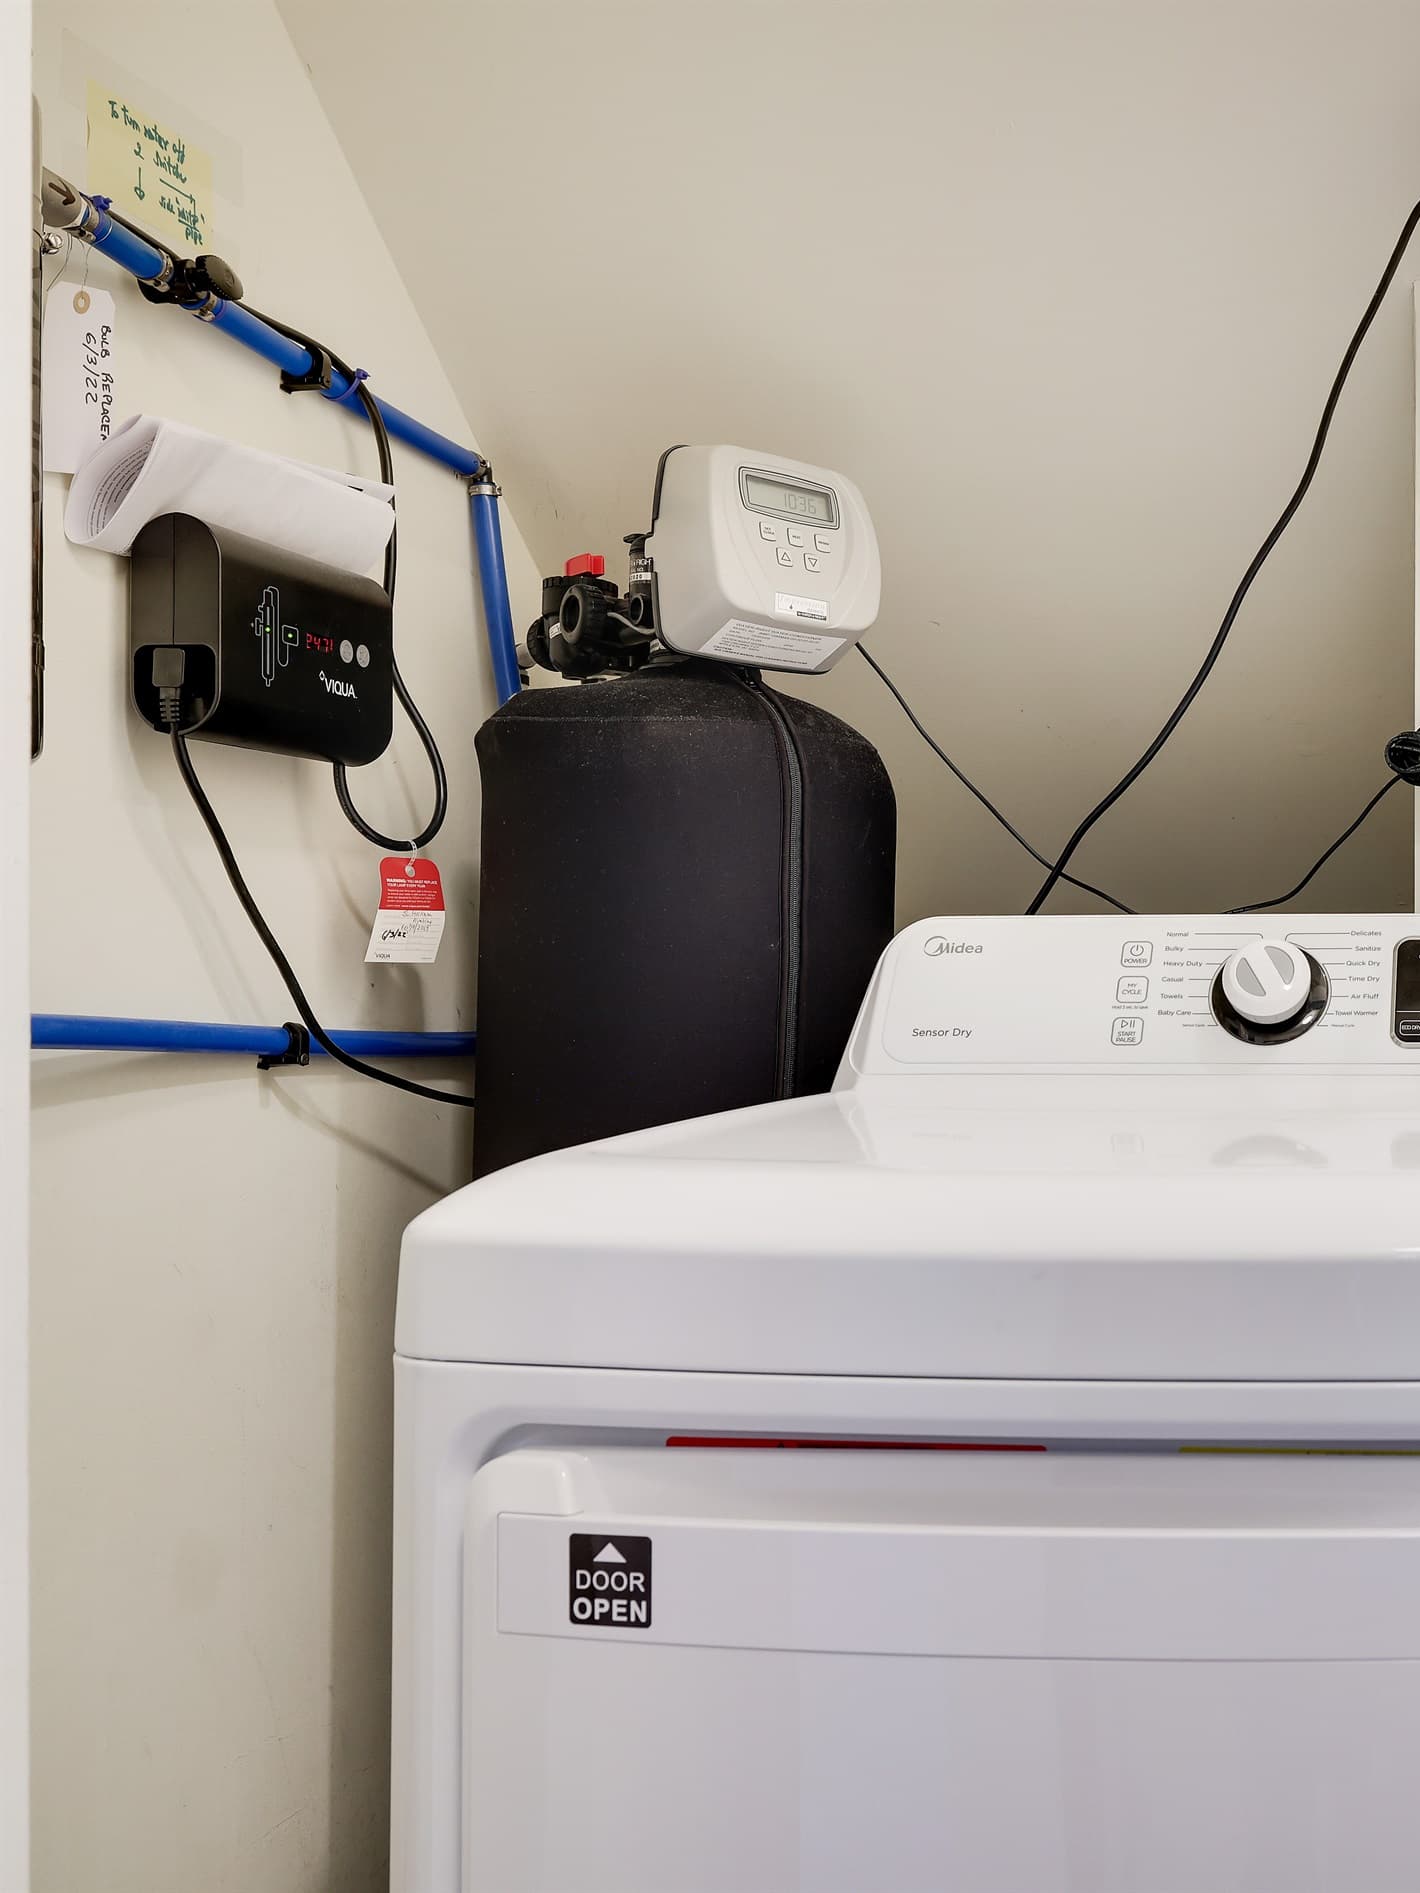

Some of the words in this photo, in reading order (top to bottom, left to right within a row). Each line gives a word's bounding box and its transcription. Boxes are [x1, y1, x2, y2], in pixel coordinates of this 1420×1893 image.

[101, 325, 112, 358] BULB
[82, 332, 100, 404] 6/3/22
[324, 678, 356, 698] VIQUA
[924, 936, 983, 956] Midea
[912, 1028, 948, 1036] Sensor
[952, 1028, 972, 1038] Dry
[575, 1569, 645, 1592] DOOR
[573, 1597, 647, 1623] OPEN
